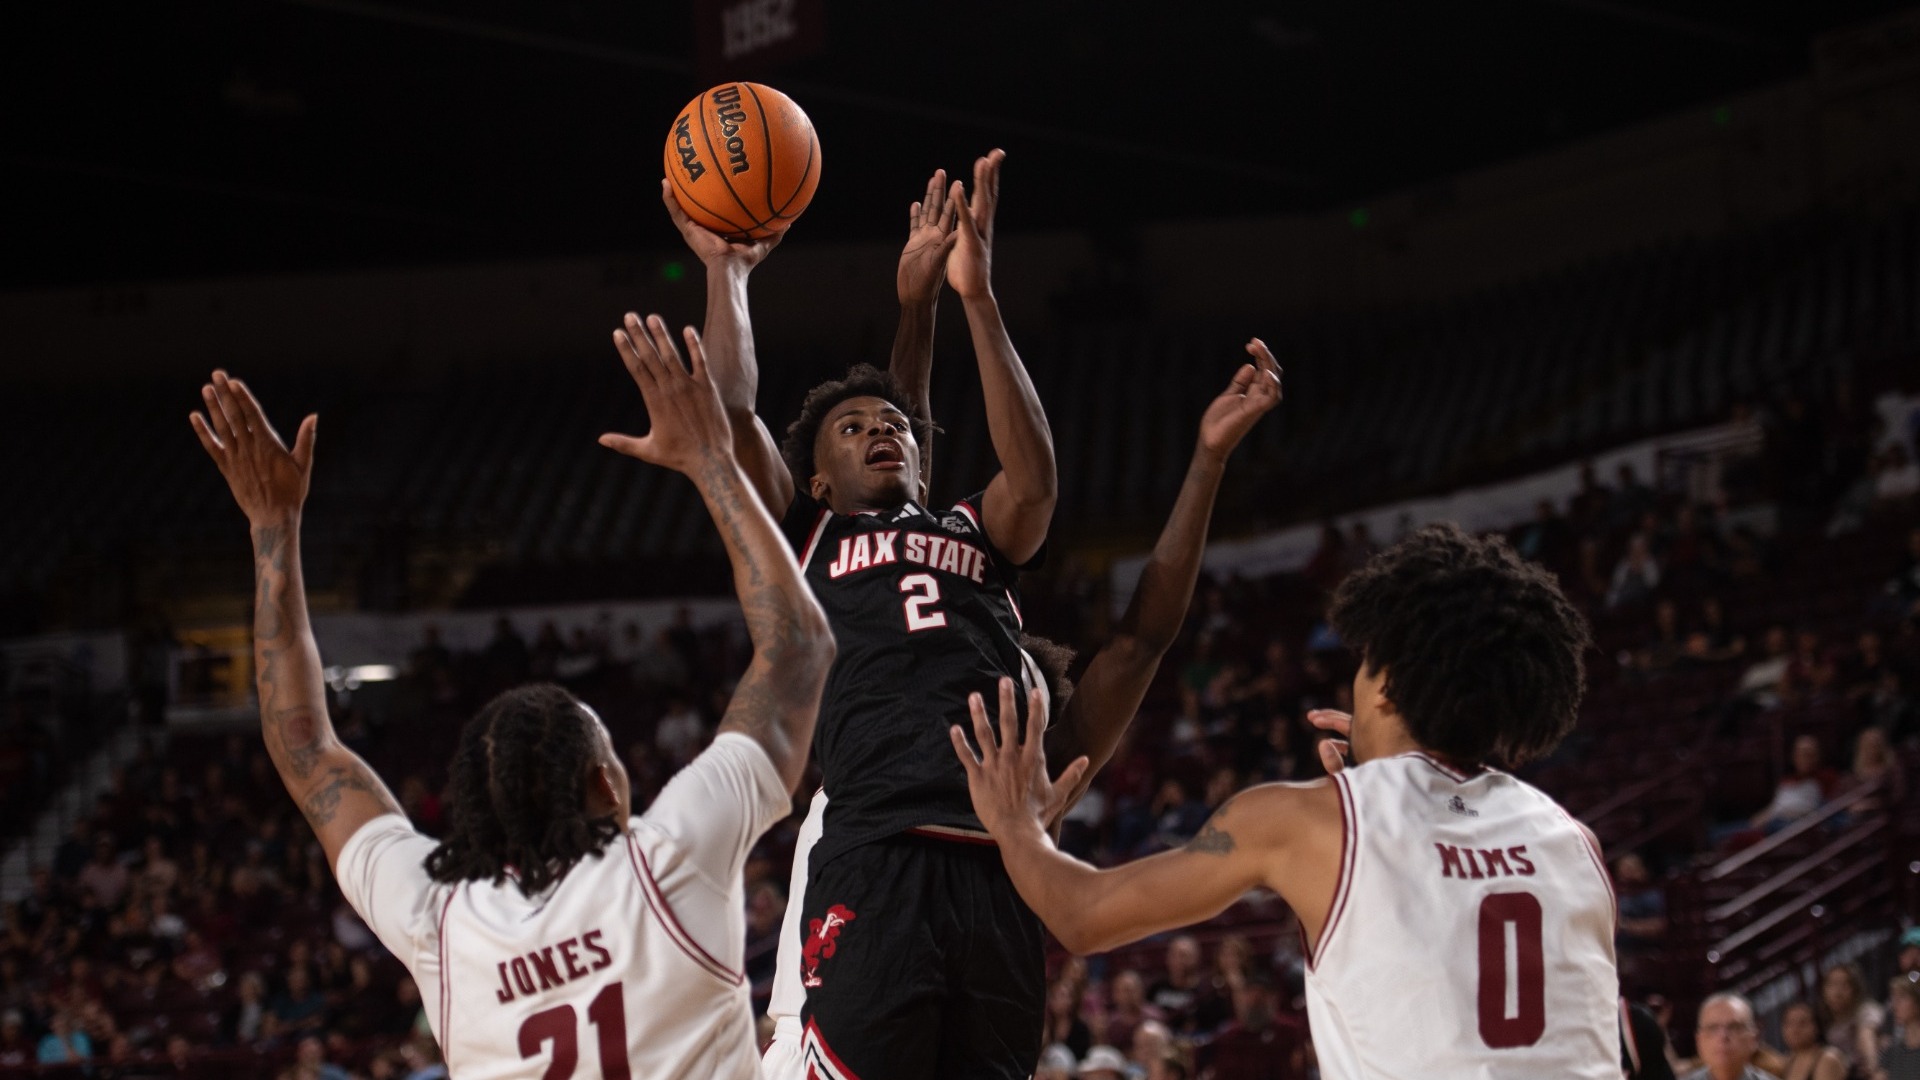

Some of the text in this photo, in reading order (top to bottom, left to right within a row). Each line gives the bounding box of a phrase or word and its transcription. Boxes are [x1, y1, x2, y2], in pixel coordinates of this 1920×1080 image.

[721, 0, 797, 60] 1952
[675, 113, 707, 184] NCAA
[712, 86, 750, 176] Wilson
[829, 530, 986, 587] JAX STATE
[899, 572, 948, 634] 2
[1434, 842, 1536, 880] MIMS
[495, 928, 613, 1005] JONES
[1478, 891, 1546, 1050] 0
[517, 981, 632, 1080] 21
